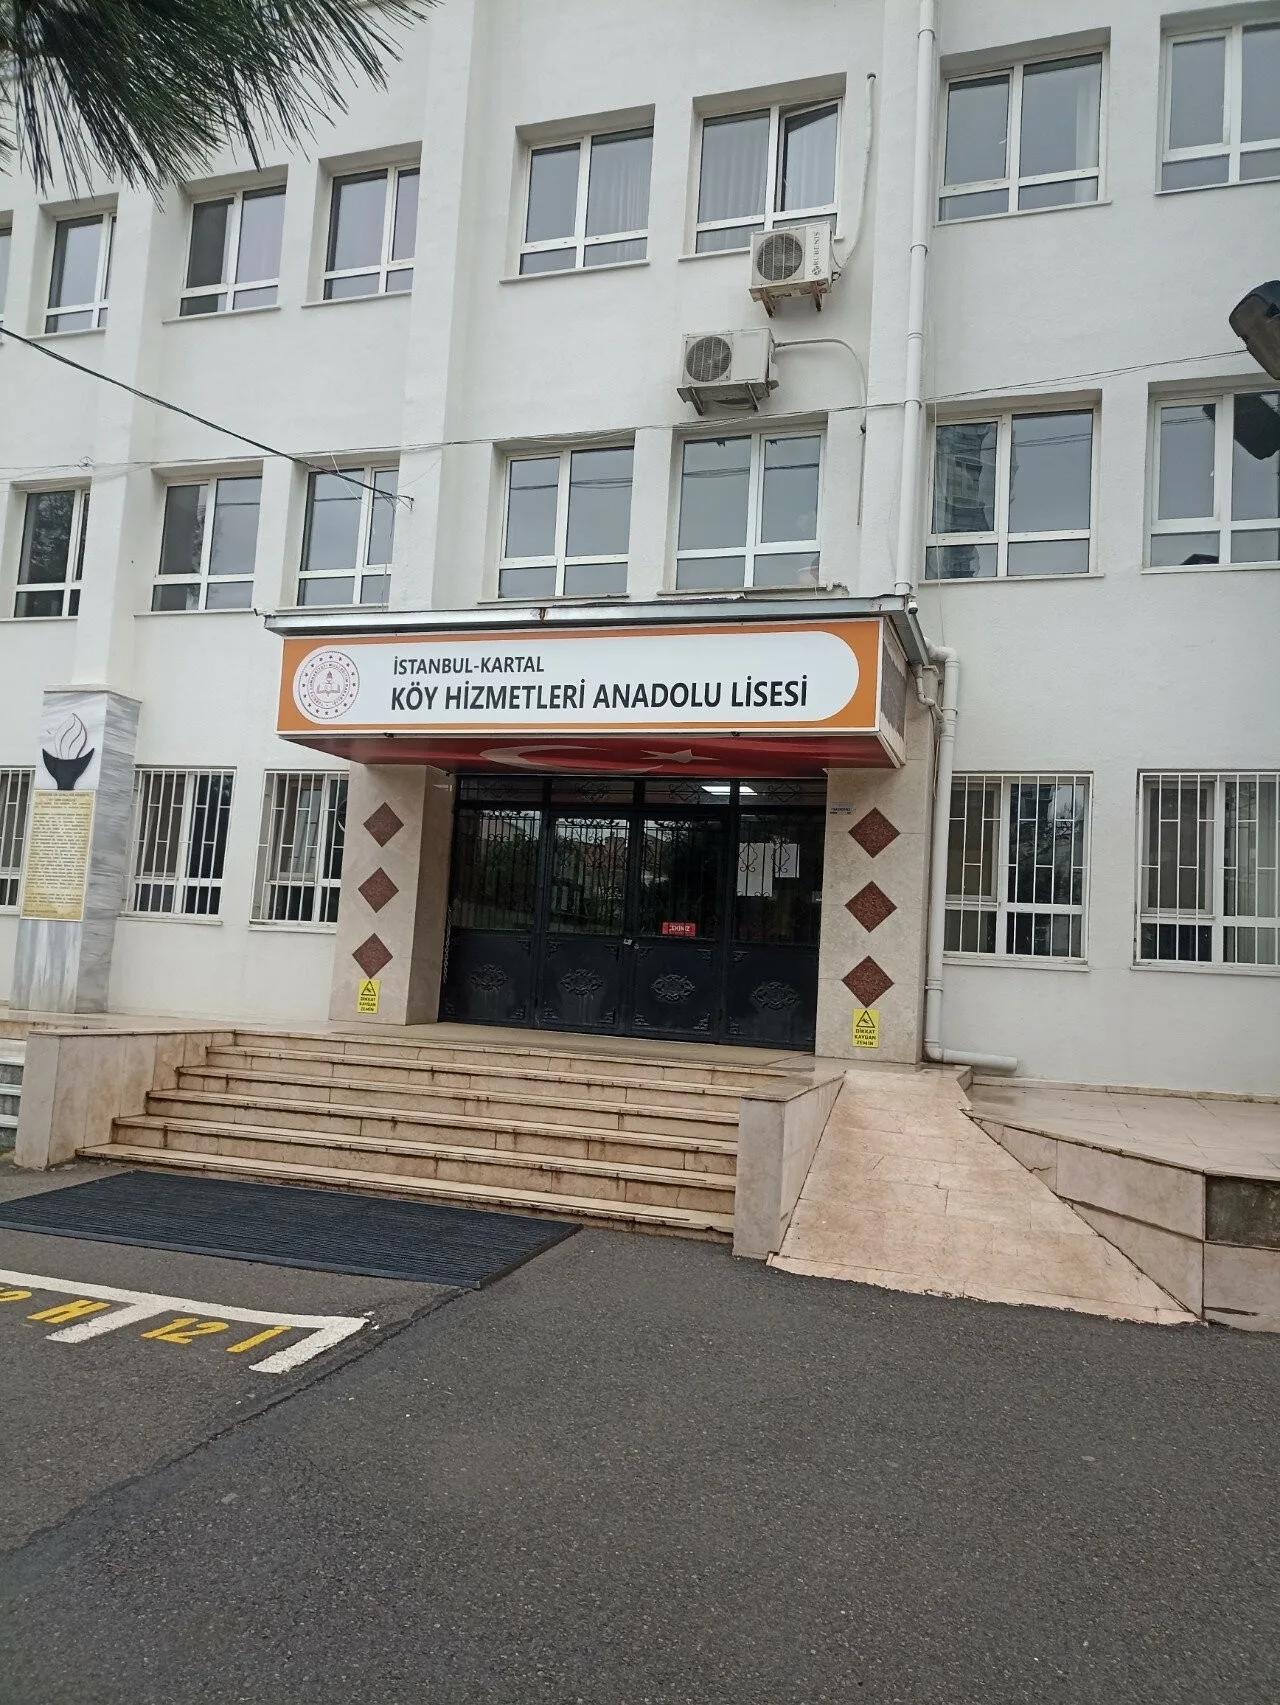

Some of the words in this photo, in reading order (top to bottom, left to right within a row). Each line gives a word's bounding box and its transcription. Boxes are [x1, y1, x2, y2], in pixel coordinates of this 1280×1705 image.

[393, 656, 545, 675] İSTANBUL-KARTAL
[391, 681, 438, 711] KÖY
[445, 679, 585, 710] HİZMETLERİ
[592, 682, 722, 709] ANADOLU
[731, 674, 808, 708] LİSESİ
[140, 1317, 230, 1344] 12
